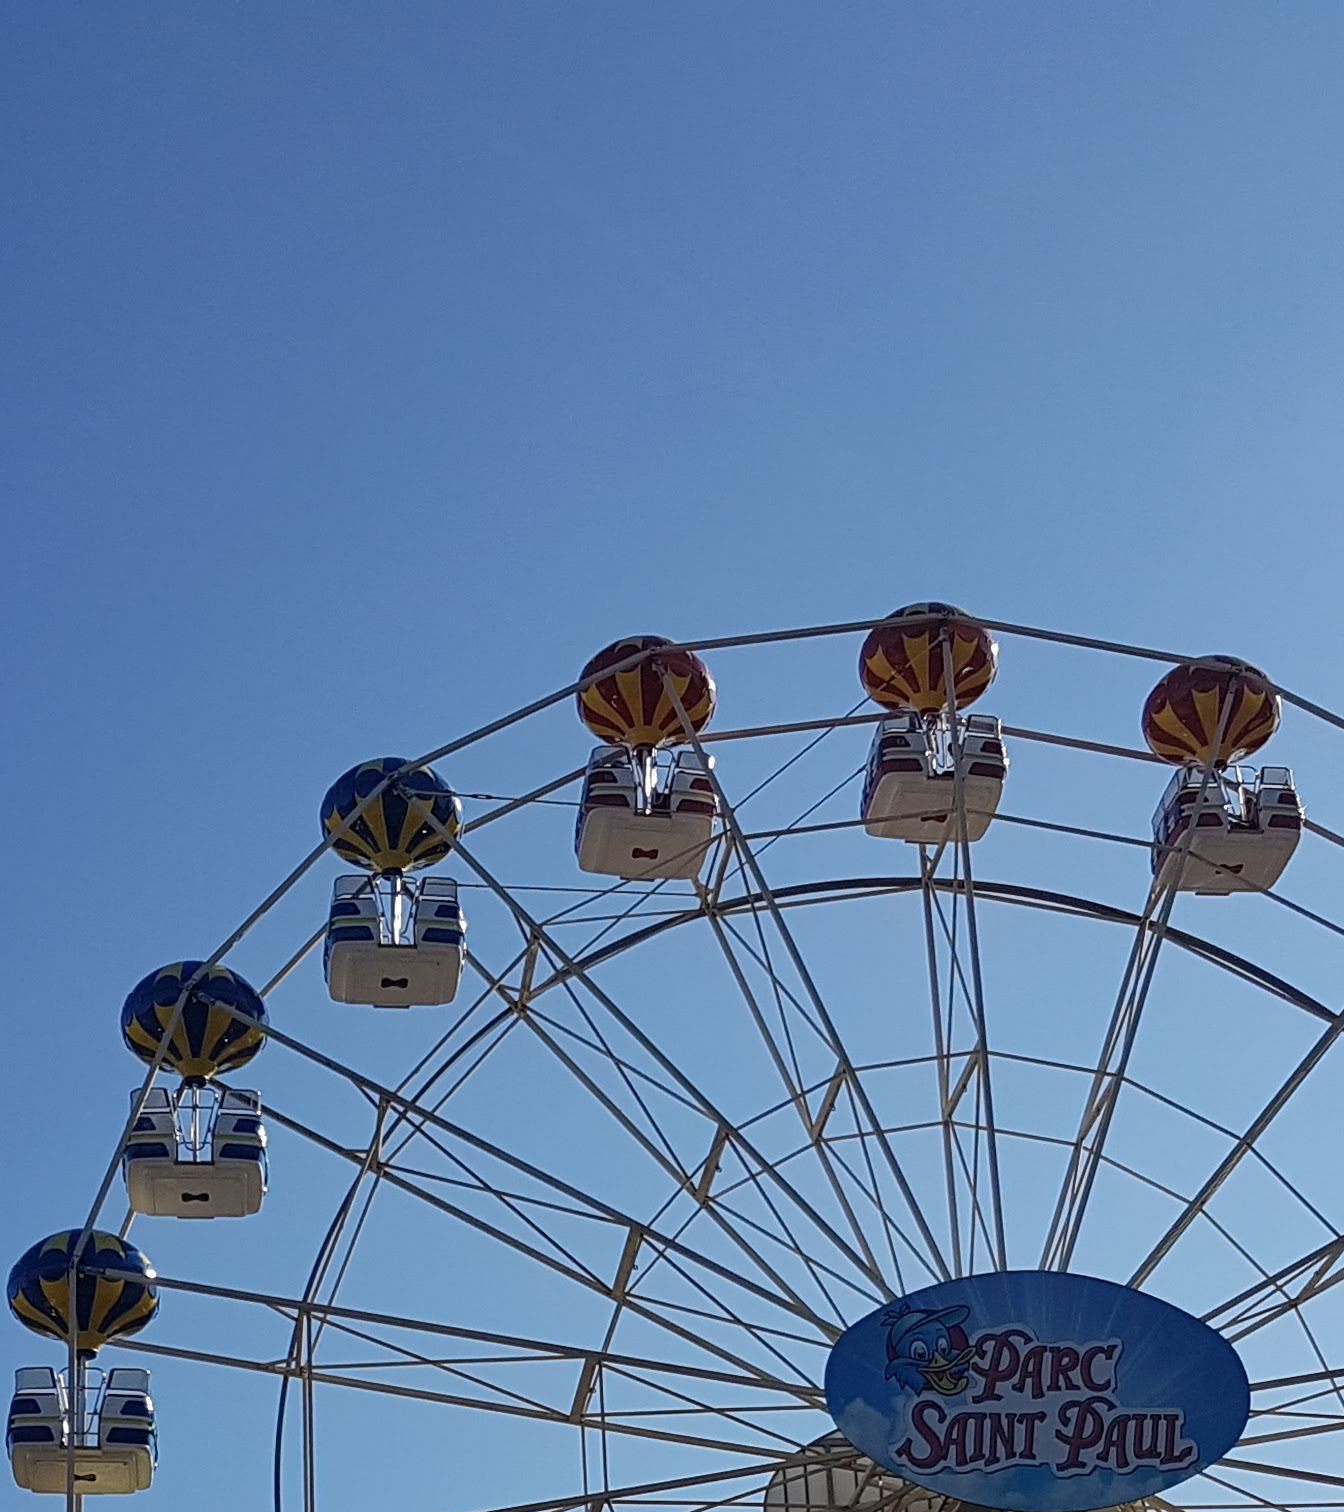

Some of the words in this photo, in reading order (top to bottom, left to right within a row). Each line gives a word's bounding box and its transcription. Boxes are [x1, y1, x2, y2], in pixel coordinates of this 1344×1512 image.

[970, 1329, 1119, 1401] PARC
[896, 1399, 1045, 1469] SAINT
[1055, 1397, 1192, 1469] PAUL
